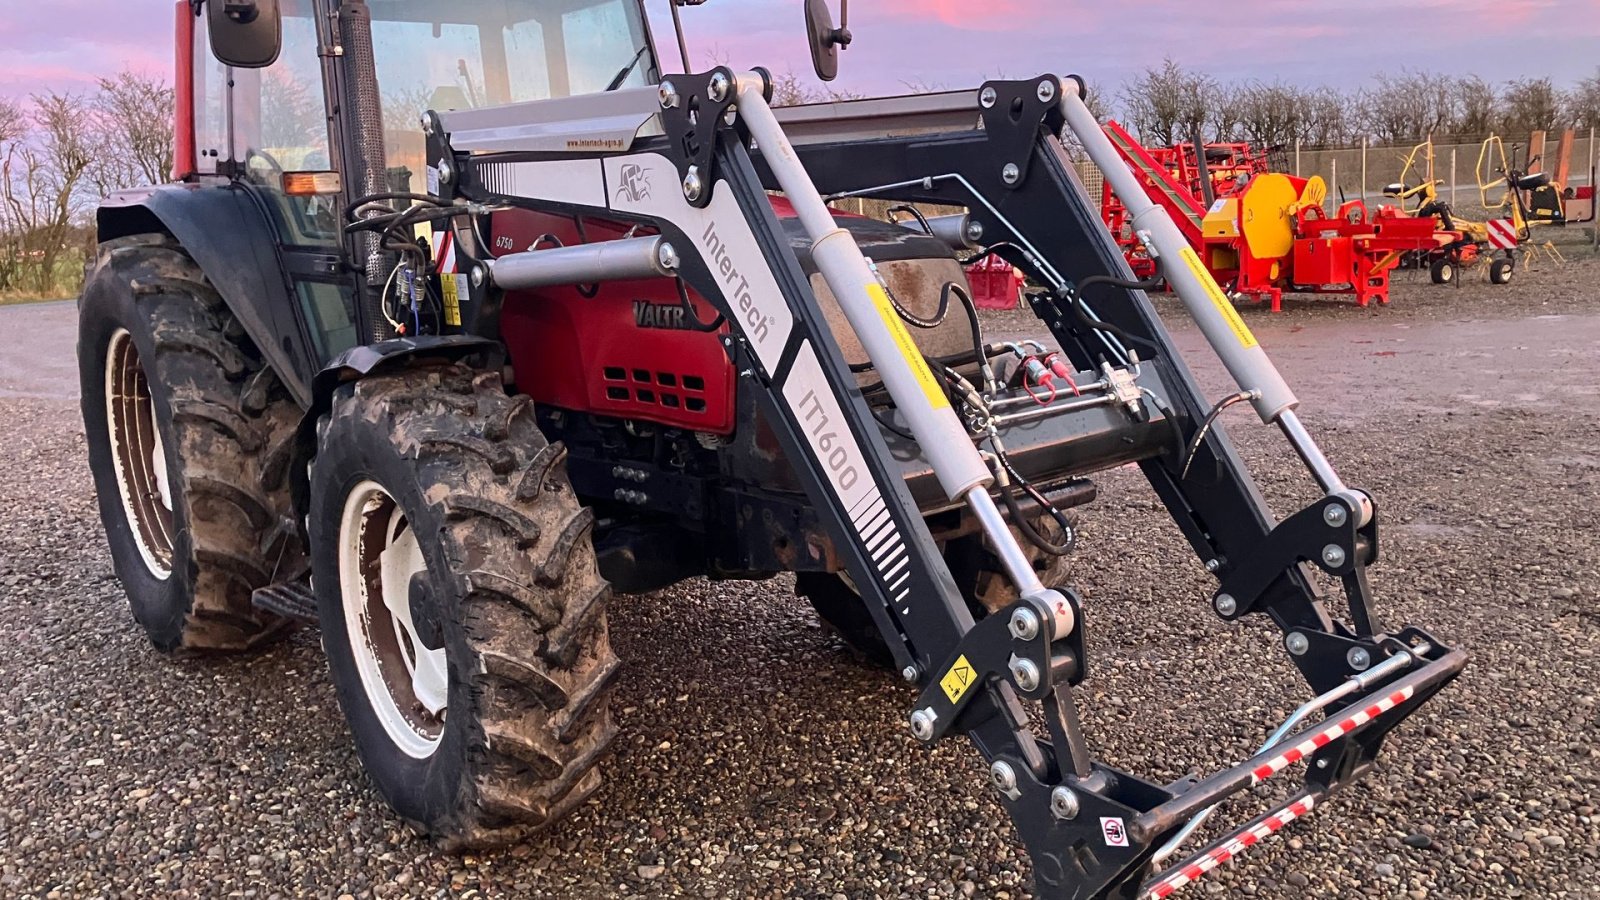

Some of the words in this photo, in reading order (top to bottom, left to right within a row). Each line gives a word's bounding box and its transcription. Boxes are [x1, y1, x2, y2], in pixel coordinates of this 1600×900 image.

[496, 236, 513, 250] 6750
[632, 300, 692, 329] VALTR
[798, 389, 858, 491] IT1600
